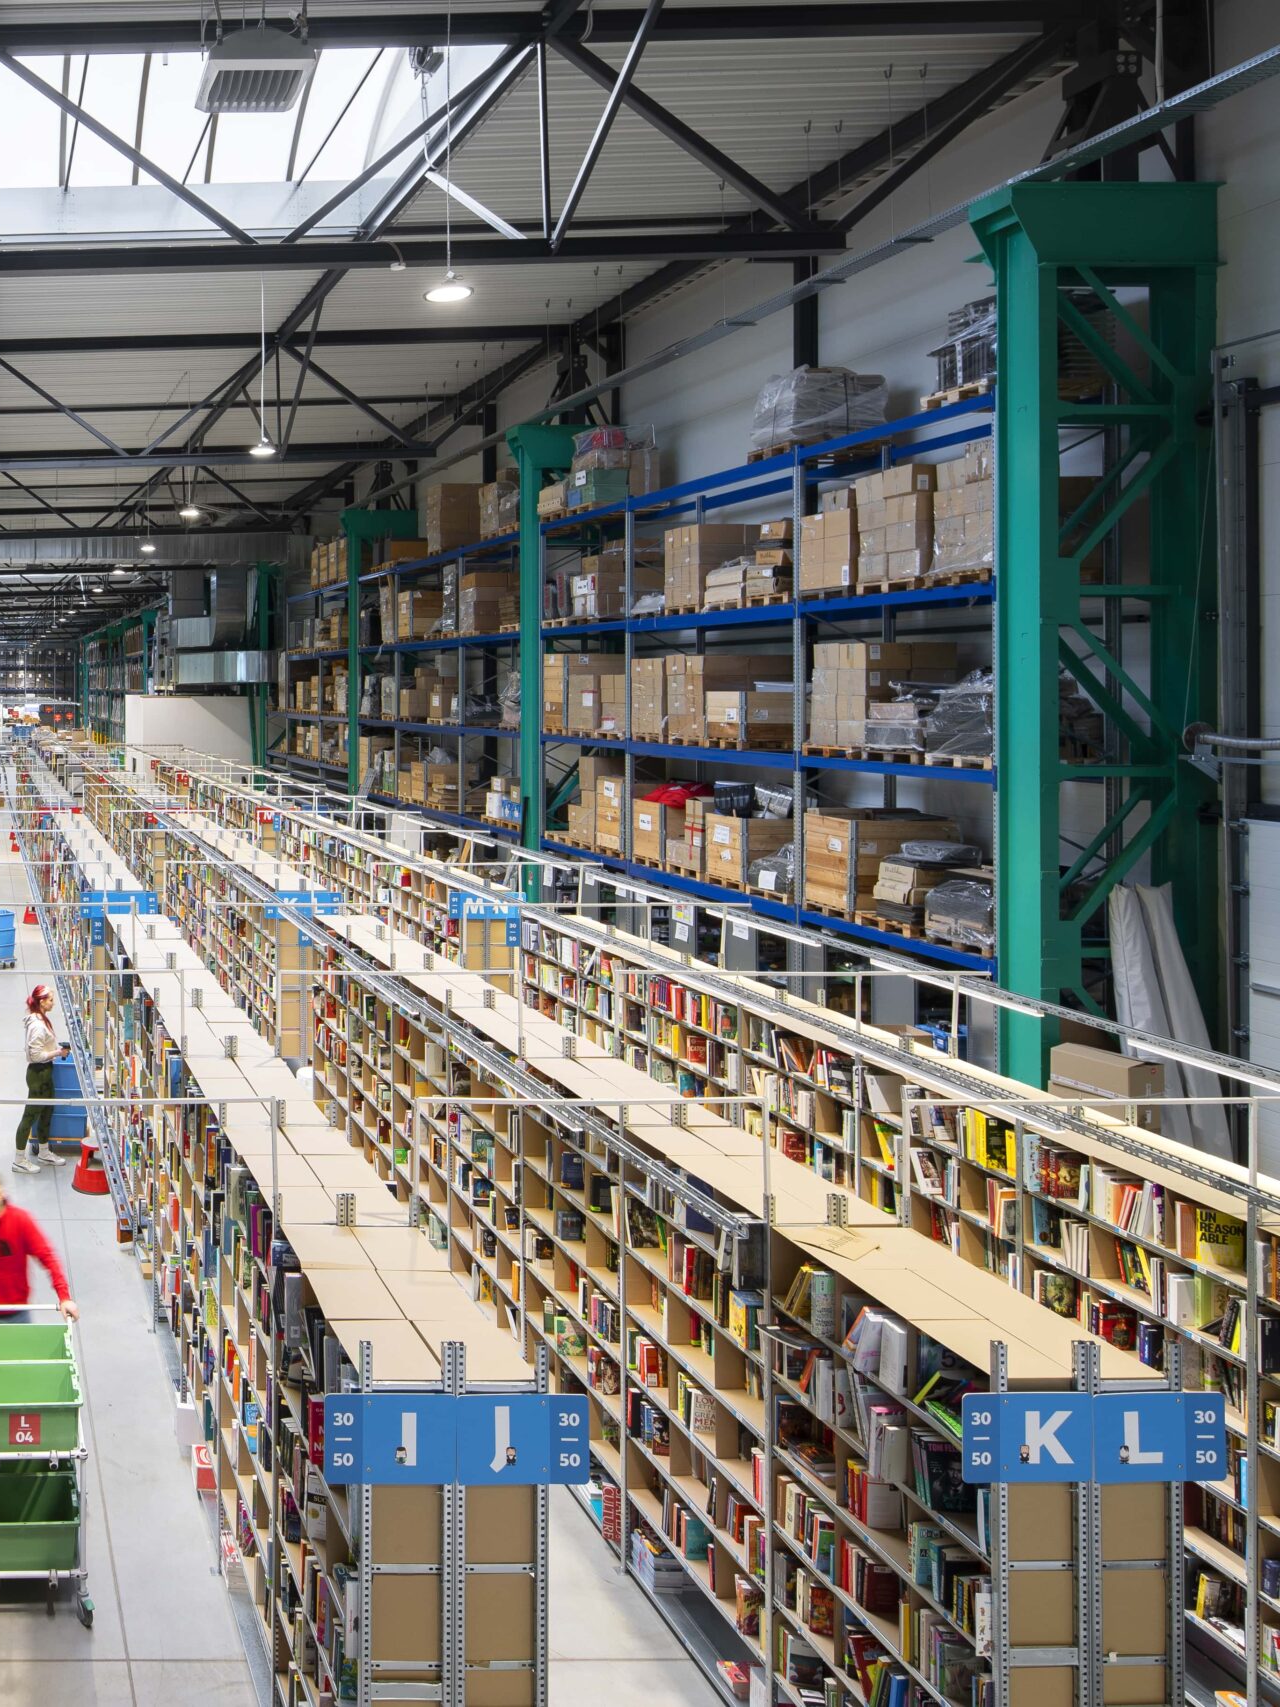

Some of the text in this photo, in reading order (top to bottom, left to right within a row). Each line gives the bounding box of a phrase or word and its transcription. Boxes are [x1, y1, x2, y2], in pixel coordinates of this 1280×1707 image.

[313, 897, 324, 914] L
[465, 897, 508, 914] M N
[1200, 1210, 1216, 1223] UN
[1200, 1222, 1244, 1236] REASON
[1200, 1233, 1228, 1245] ABLE
[695, 1396, 715, 1404] LOV
[20, 1415, 30, 1428] L
[333, 1412, 354, 1426] 30
[558, 1413, 580, 1427] 30
[971, 1412, 991, 1426] 30
[1194, 1410, 1216, 1424] 30
[15, 1431, 34, 1444] 04
[401, 1406, 510, 1473] I J
[1024, 1410, 1163, 1464] K L
[928, 1443, 944, 1452] TOM
[333, 1453, 354, 1467] 50
[559, 1453, 581, 1467] 50
[971, 1452, 992, 1466] 50
[1195, 1450, 1217, 1464] 50
[603, 1487, 614, 1540] CULTURE
